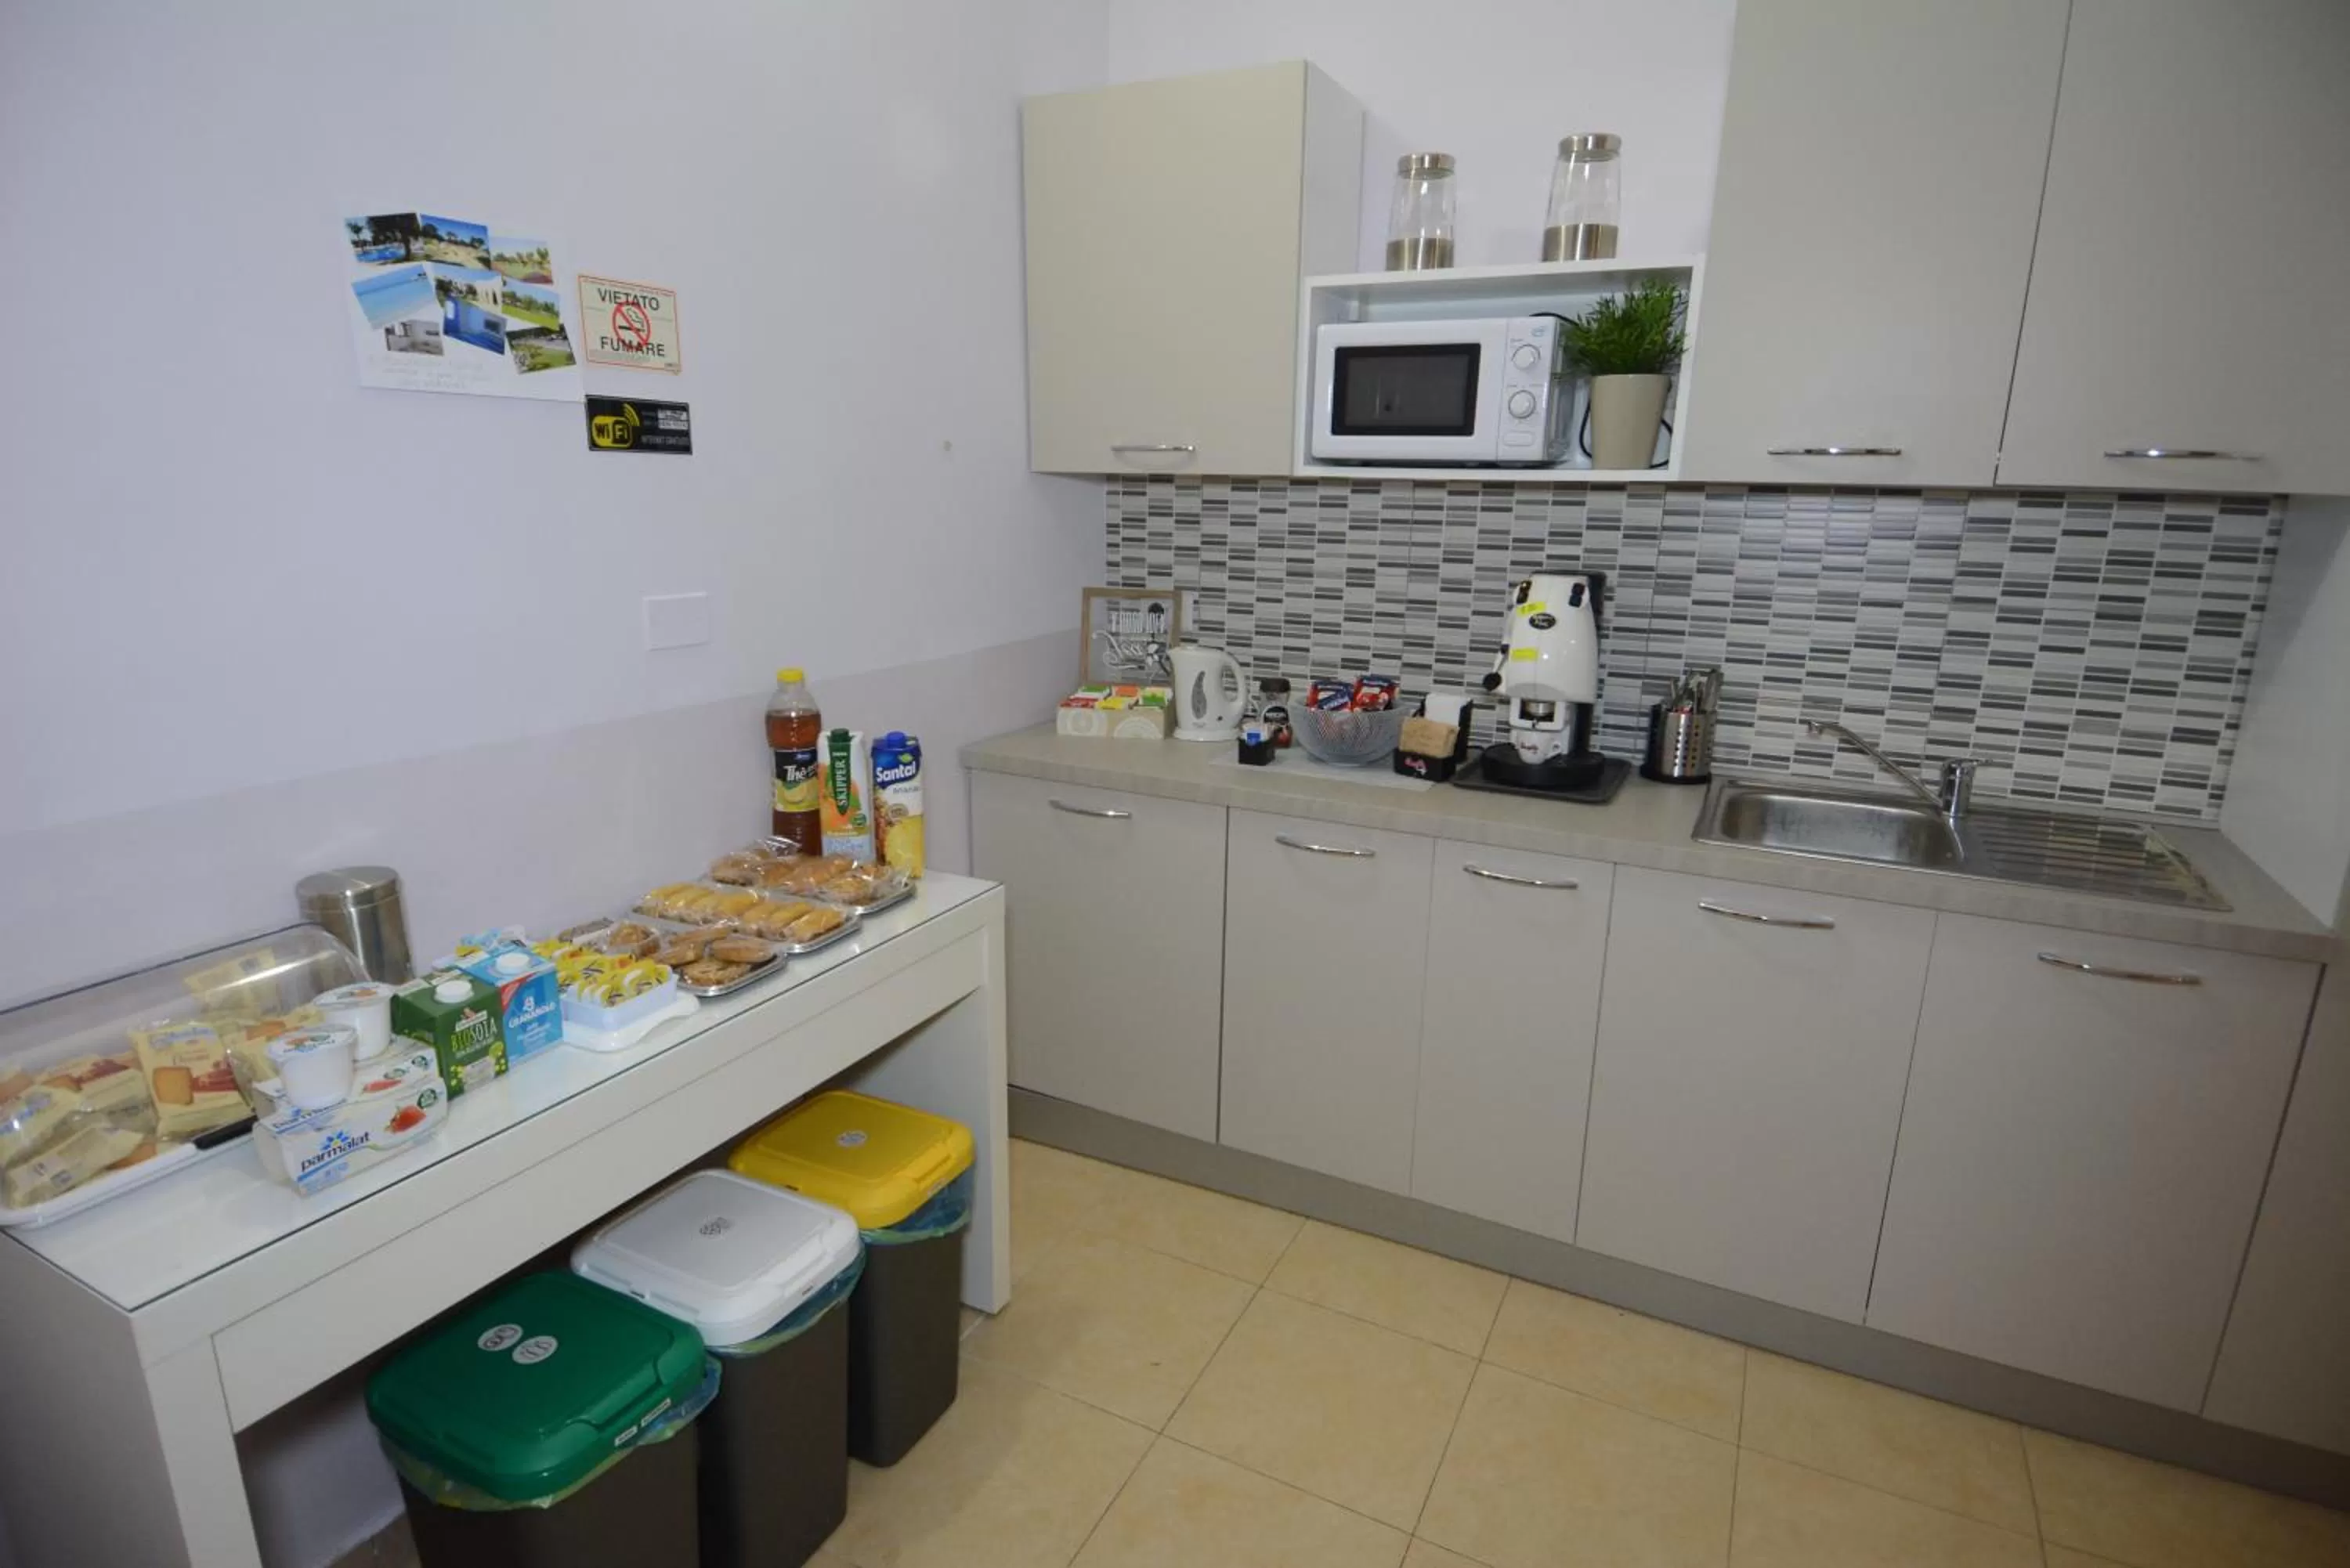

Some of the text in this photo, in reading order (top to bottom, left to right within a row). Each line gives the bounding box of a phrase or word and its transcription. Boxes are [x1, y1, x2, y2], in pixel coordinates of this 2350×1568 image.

[598, 287, 660, 311] VIETATO
[600, 336, 665, 357] FUMARE
[835, 760, 848, 806] SKIPPER
[876, 761, 916, 782] Santal
[301, 1131, 369, 1172] parmalat
